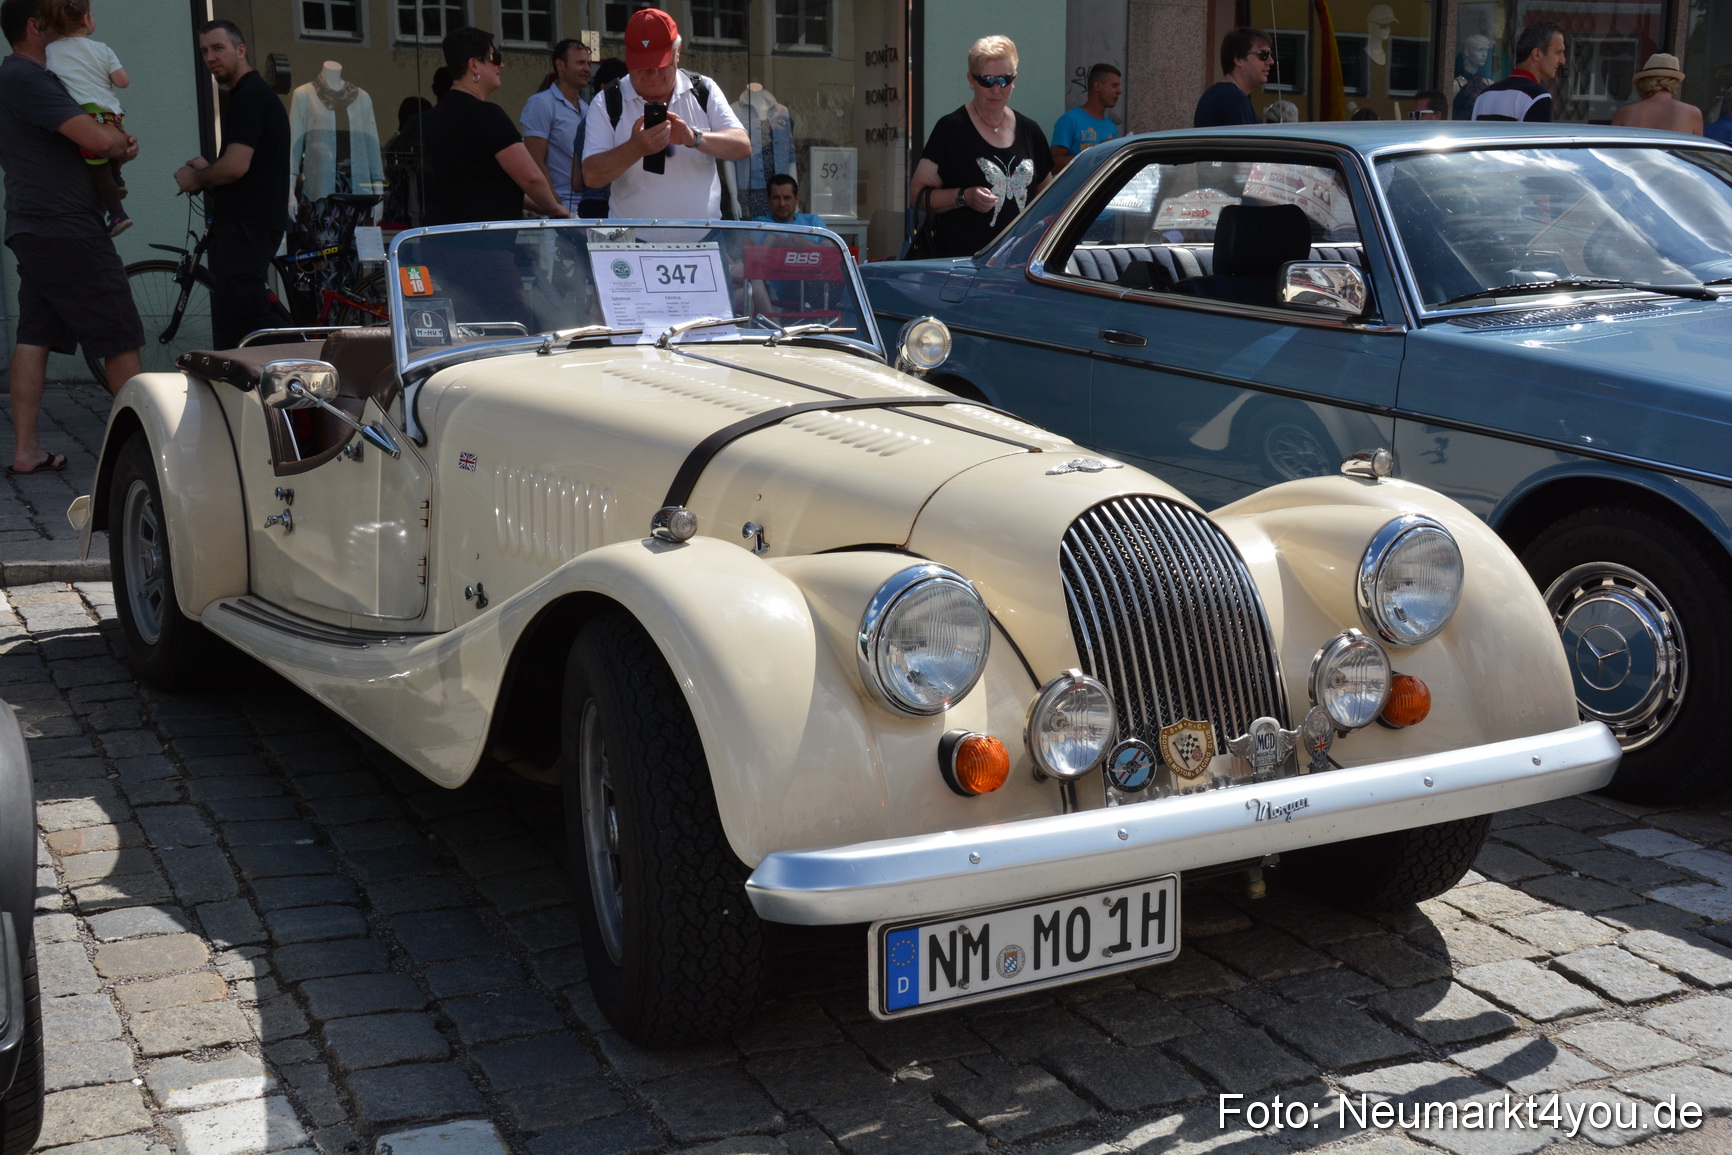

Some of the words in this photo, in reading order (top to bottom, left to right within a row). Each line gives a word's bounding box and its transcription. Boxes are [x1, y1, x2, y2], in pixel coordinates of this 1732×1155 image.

[784, 251, 821, 265] BBS
[656, 264, 698, 285] 347
[1257, 732, 1275, 752] MCD
[1171, 763, 1192, 777] MOTOR
[1195, 751, 1211, 774] RACING
[1205, 730, 1213, 749] CLUB
[1245, 797, 1311, 823] Morgan
[929, 923, 990, 991] NM
[898, 976, 909, 994] D
